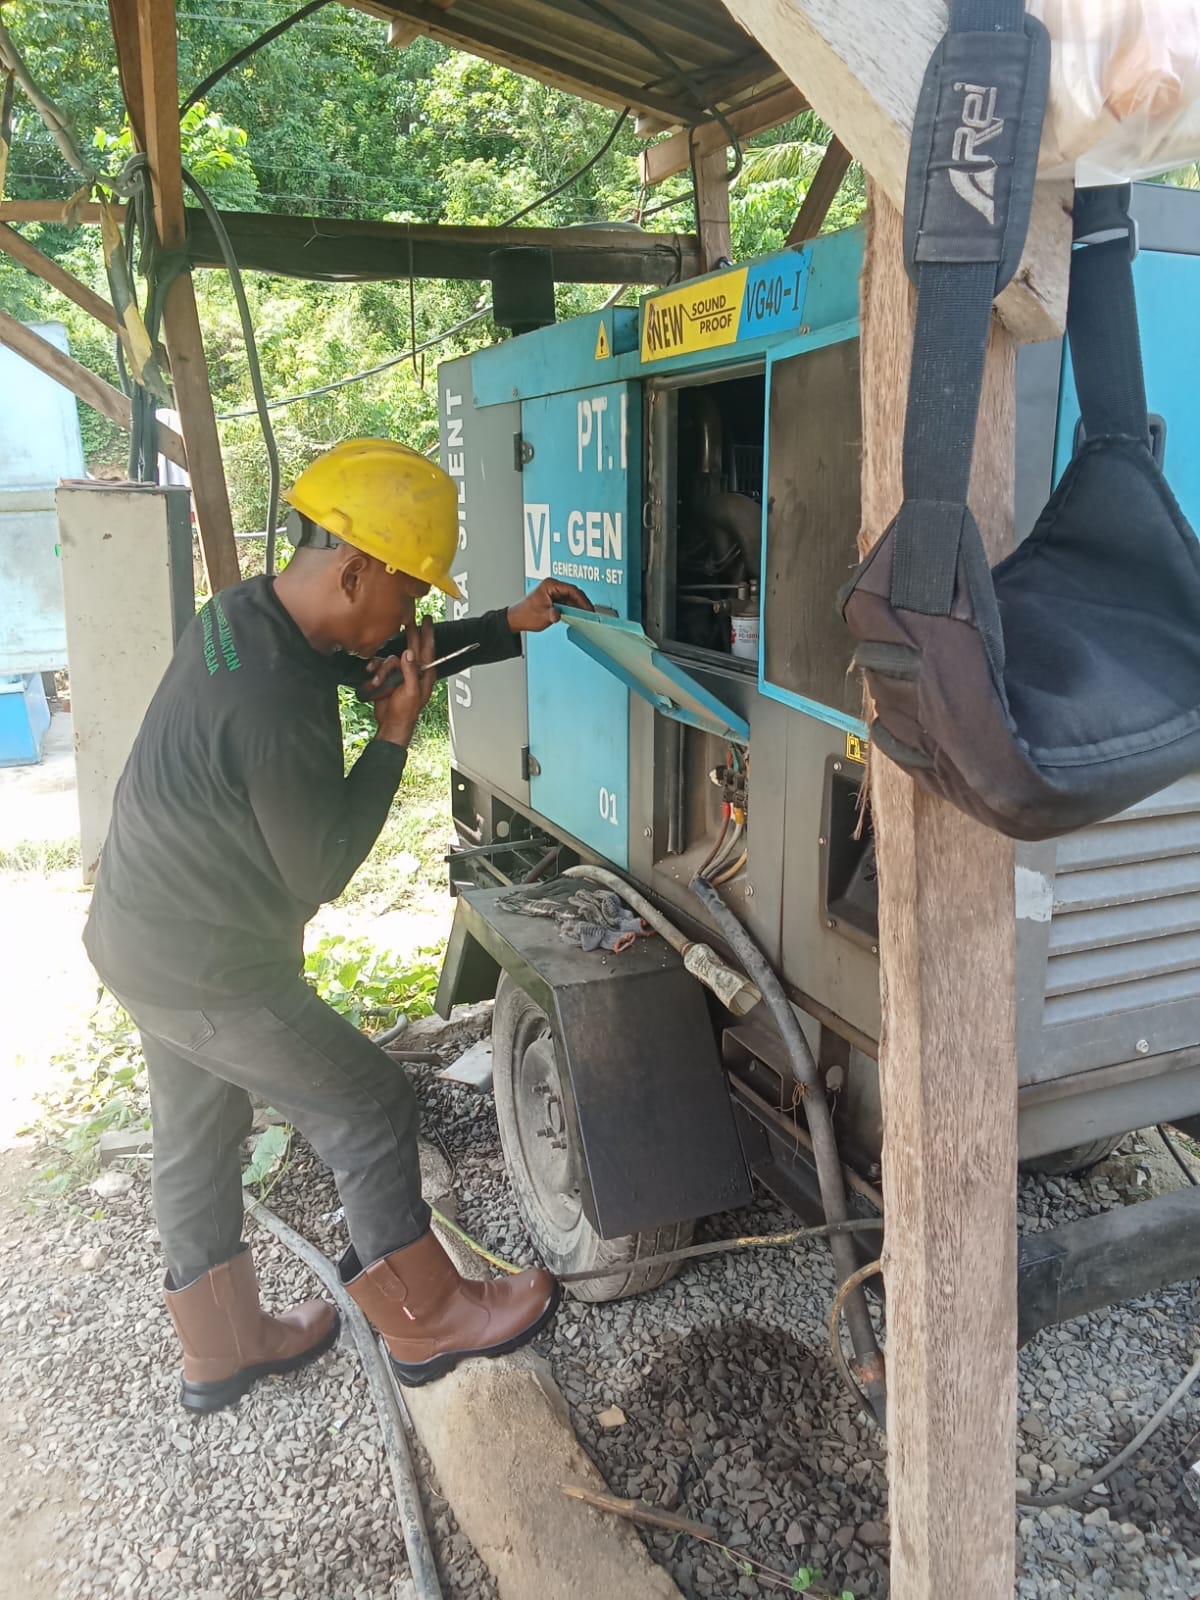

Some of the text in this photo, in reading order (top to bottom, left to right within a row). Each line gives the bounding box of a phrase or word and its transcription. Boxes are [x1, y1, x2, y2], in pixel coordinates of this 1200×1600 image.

[692, 294, 726, 317] SOUND
[699, 313, 733, 335] PROOF
[647, 302, 684, 353] NEW
[453, 571, 472, 709] URA
[599, 786, 618, 825] 01
